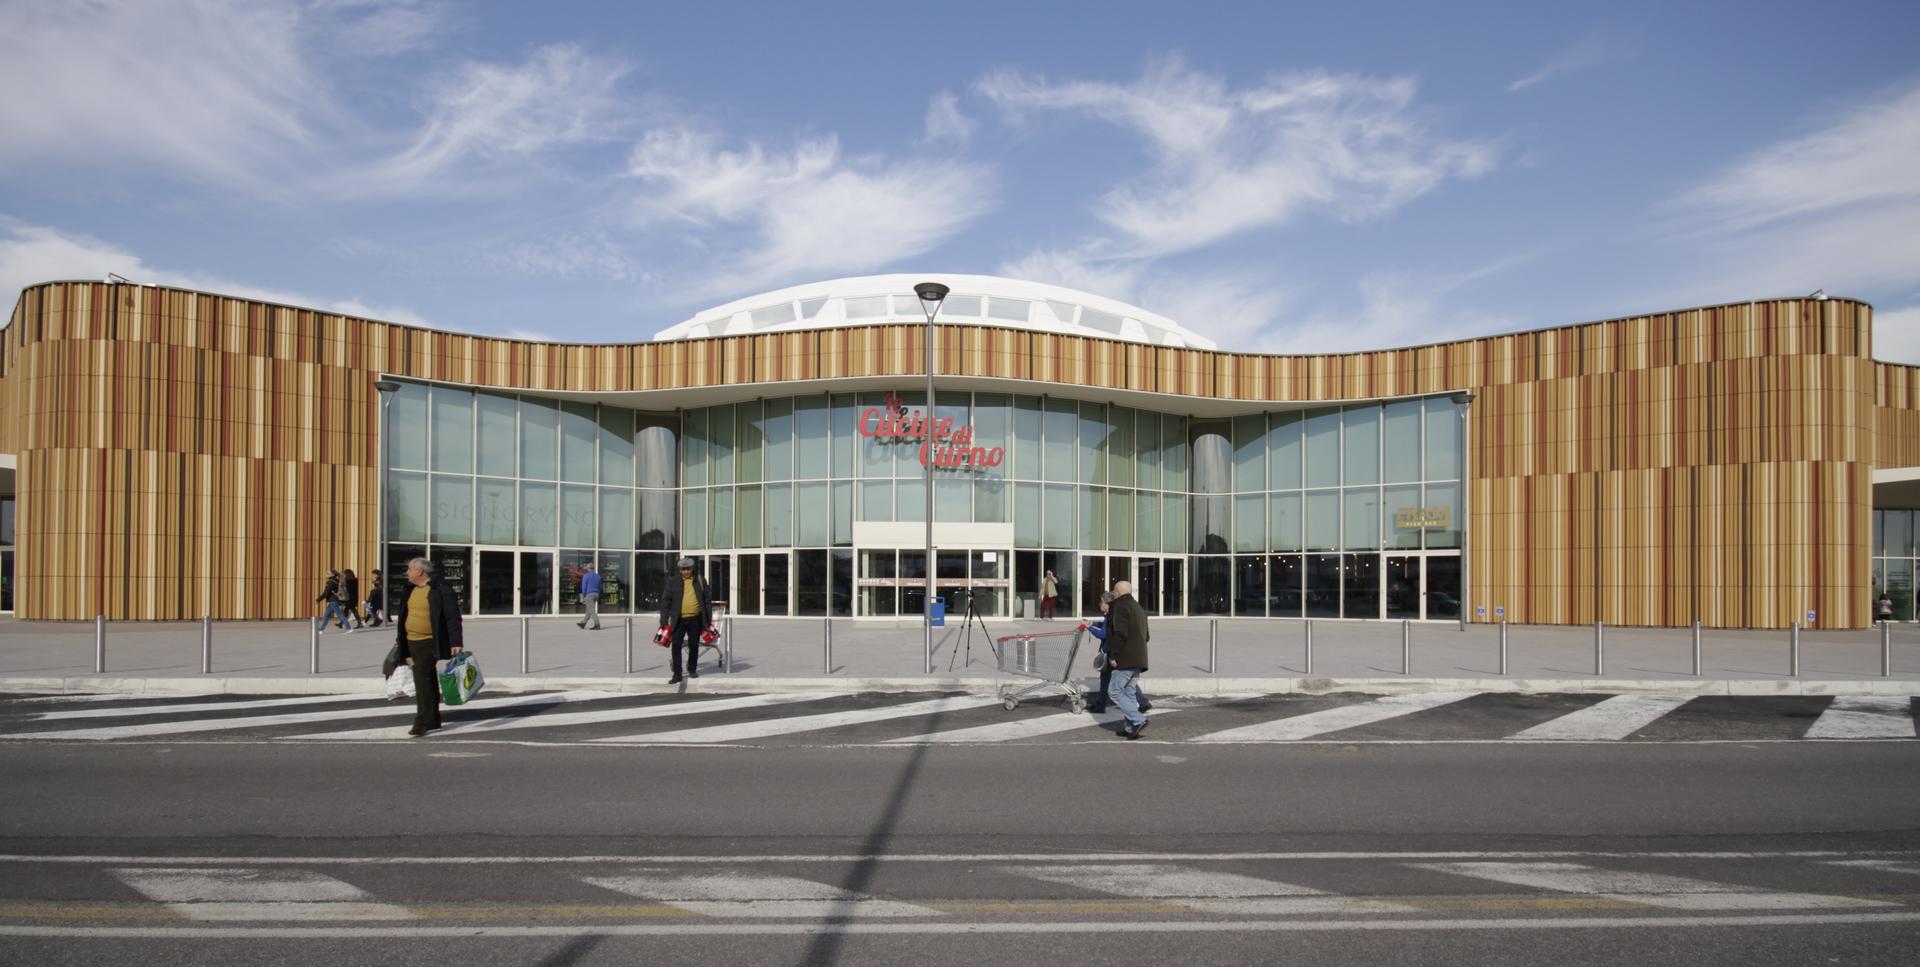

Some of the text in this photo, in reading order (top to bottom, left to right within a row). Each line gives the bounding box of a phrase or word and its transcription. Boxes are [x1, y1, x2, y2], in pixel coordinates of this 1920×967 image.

[951, 424, 974, 445] di
[918, 438, 1005, 468] Curno
[438, 501, 595, 527] SIGNORVNO
